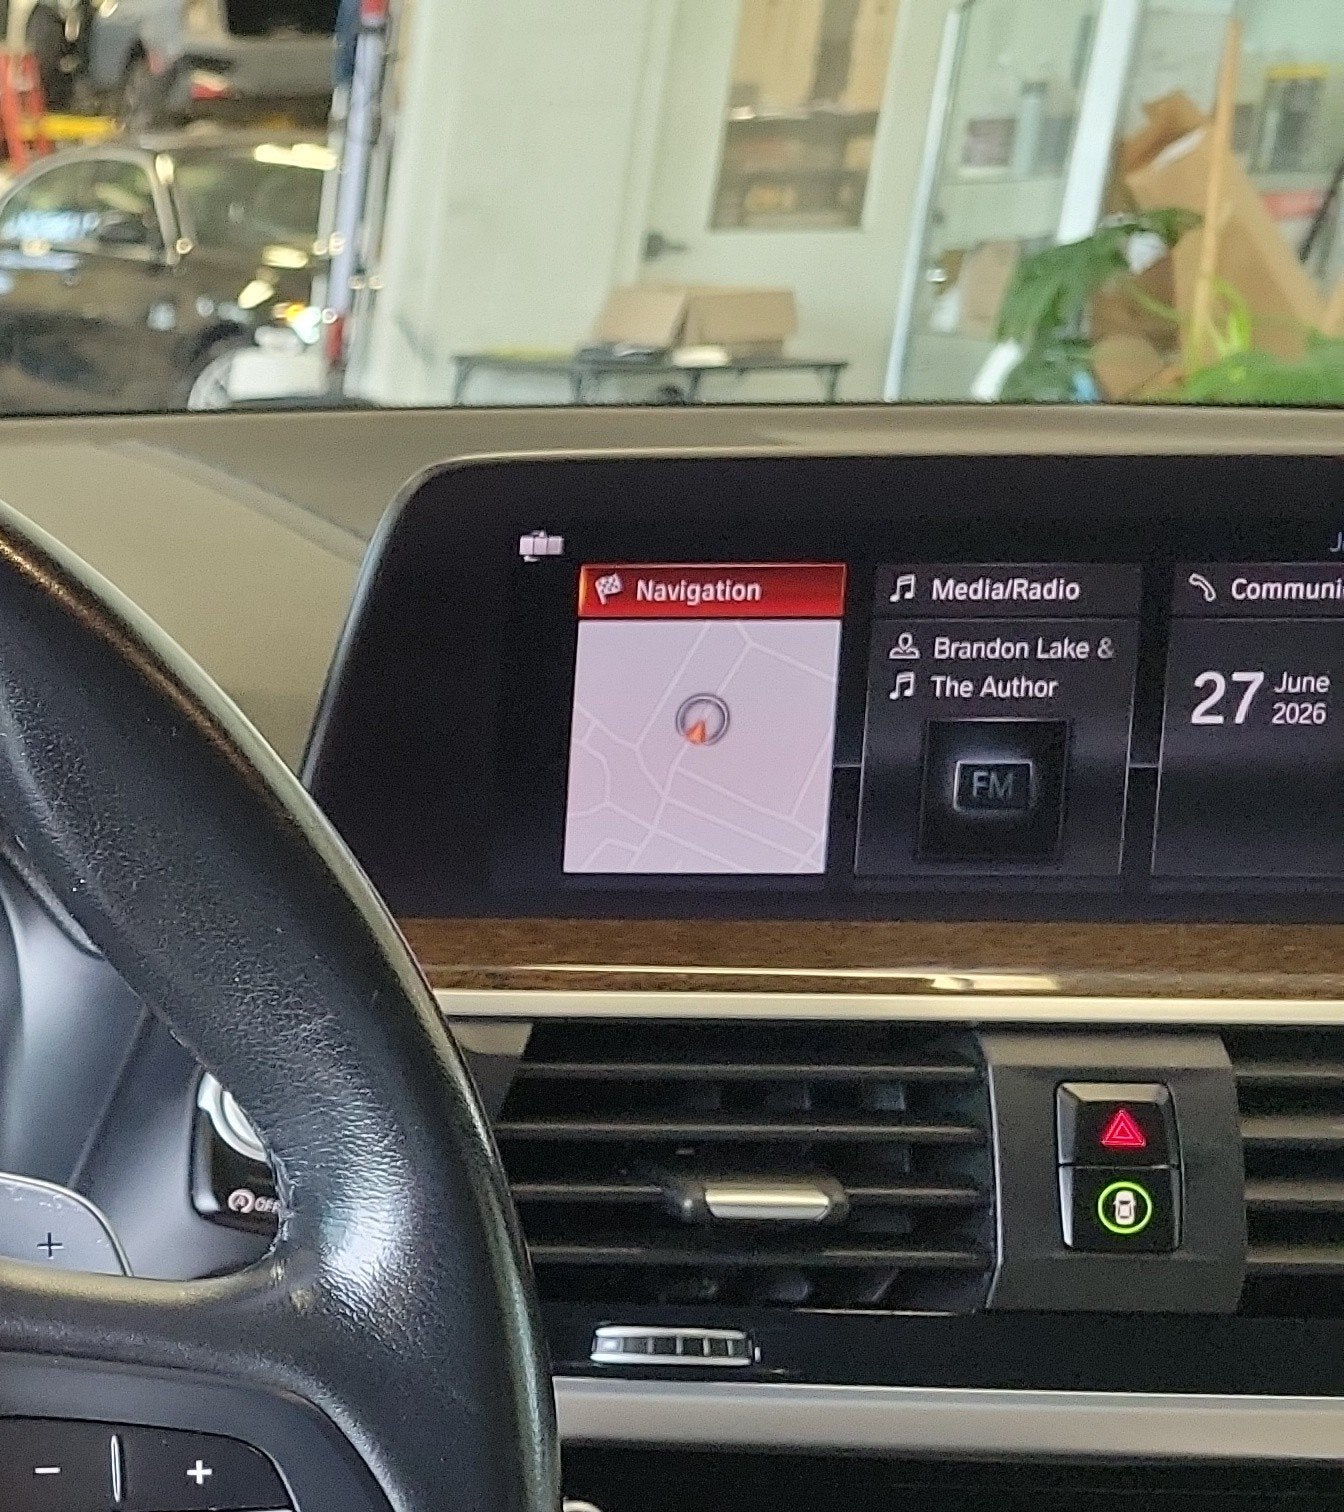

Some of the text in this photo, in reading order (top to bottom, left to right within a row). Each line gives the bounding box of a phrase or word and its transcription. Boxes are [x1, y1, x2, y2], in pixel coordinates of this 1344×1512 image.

[636, 578, 762, 606] Navigation
[931, 577, 1081, 601] Media/Radio
[1230, 576, 1344, 601] Communi
[933, 636, 1114, 660] Brandon Lake &
[929, 675, 1060, 698] The Author
[1273, 671, 1331, 694] June
[1190, 670, 1266, 726] 27
[1271, 702, 1328, 726] 2026
[971, 770, 1014, 800] FM
